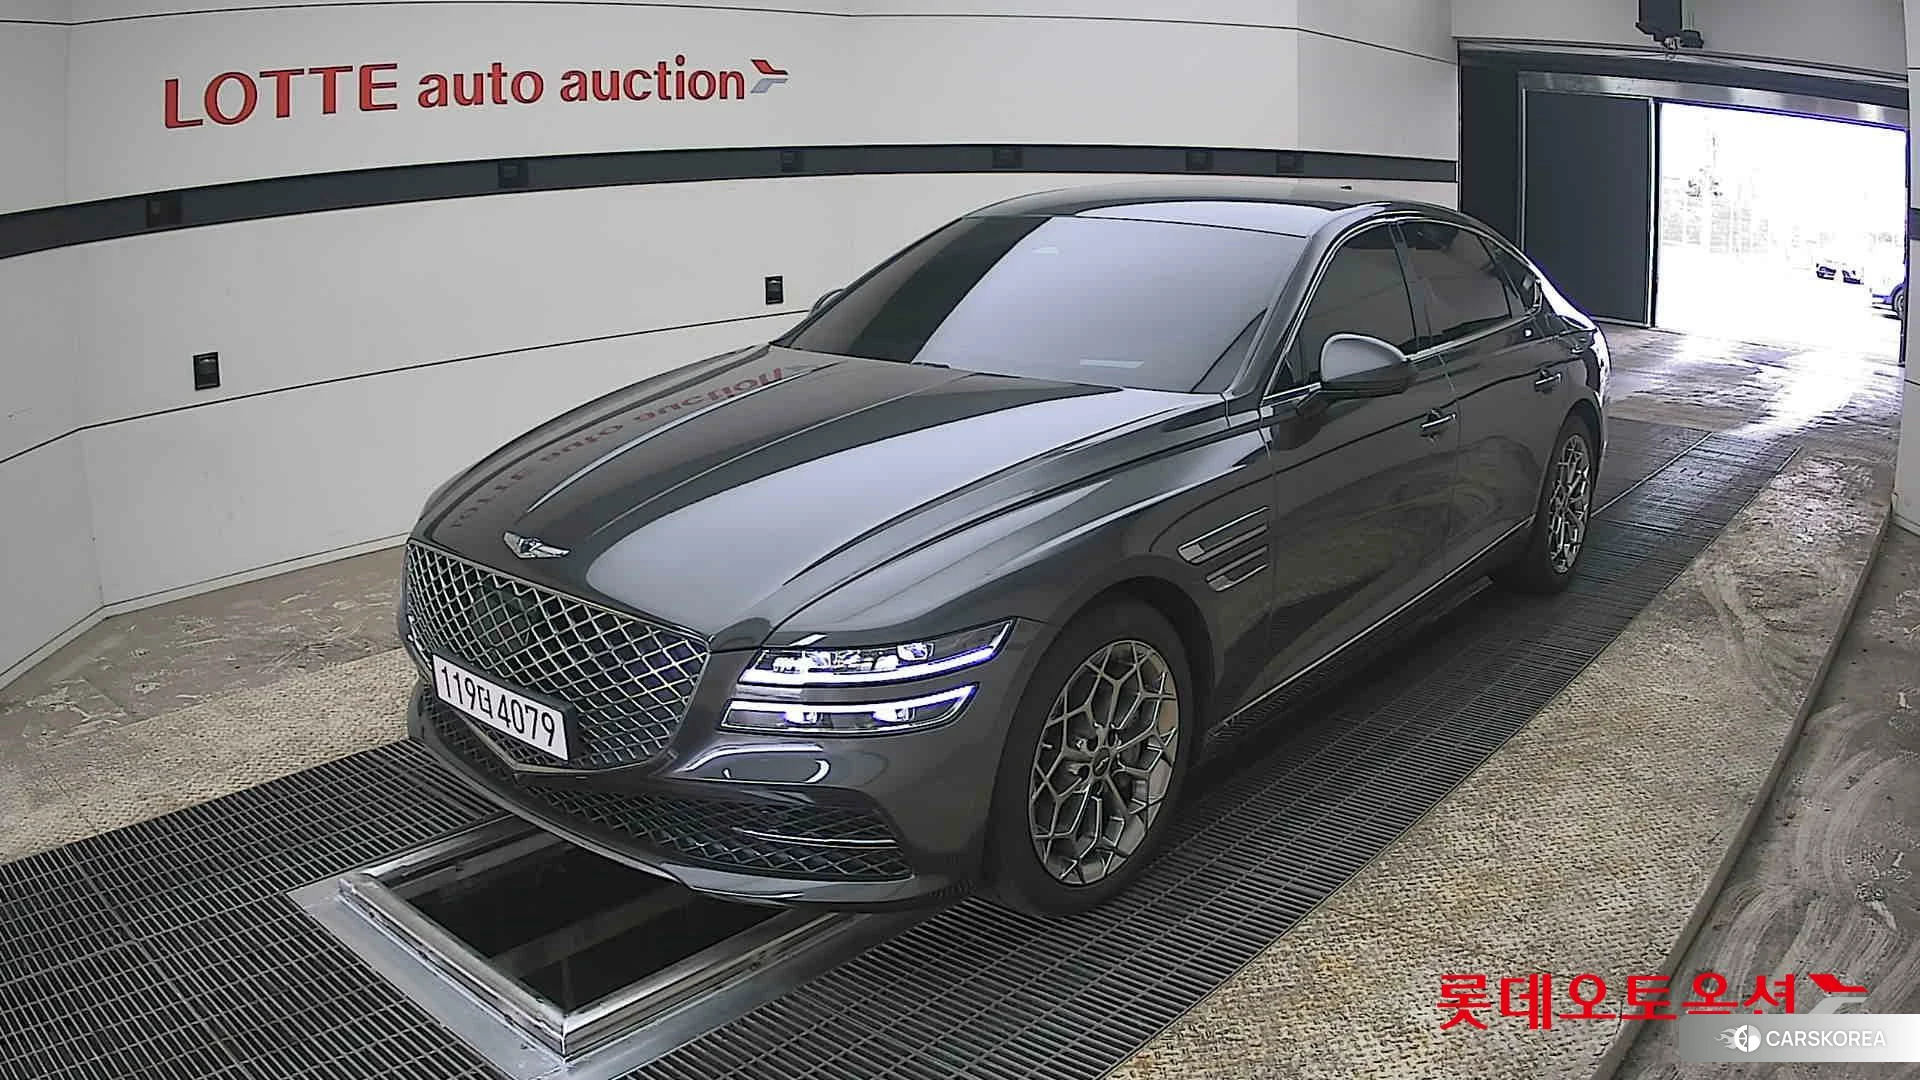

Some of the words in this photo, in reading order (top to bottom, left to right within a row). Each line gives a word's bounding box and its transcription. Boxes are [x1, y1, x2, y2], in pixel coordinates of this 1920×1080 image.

[163, 62, 398, 129] LOTTE
[417, 62, 545, 108] auto
[559, 55, 746, 102] auction
[441, 666, 493, 719] 119더
[497, 693, 556, 748] 4079
